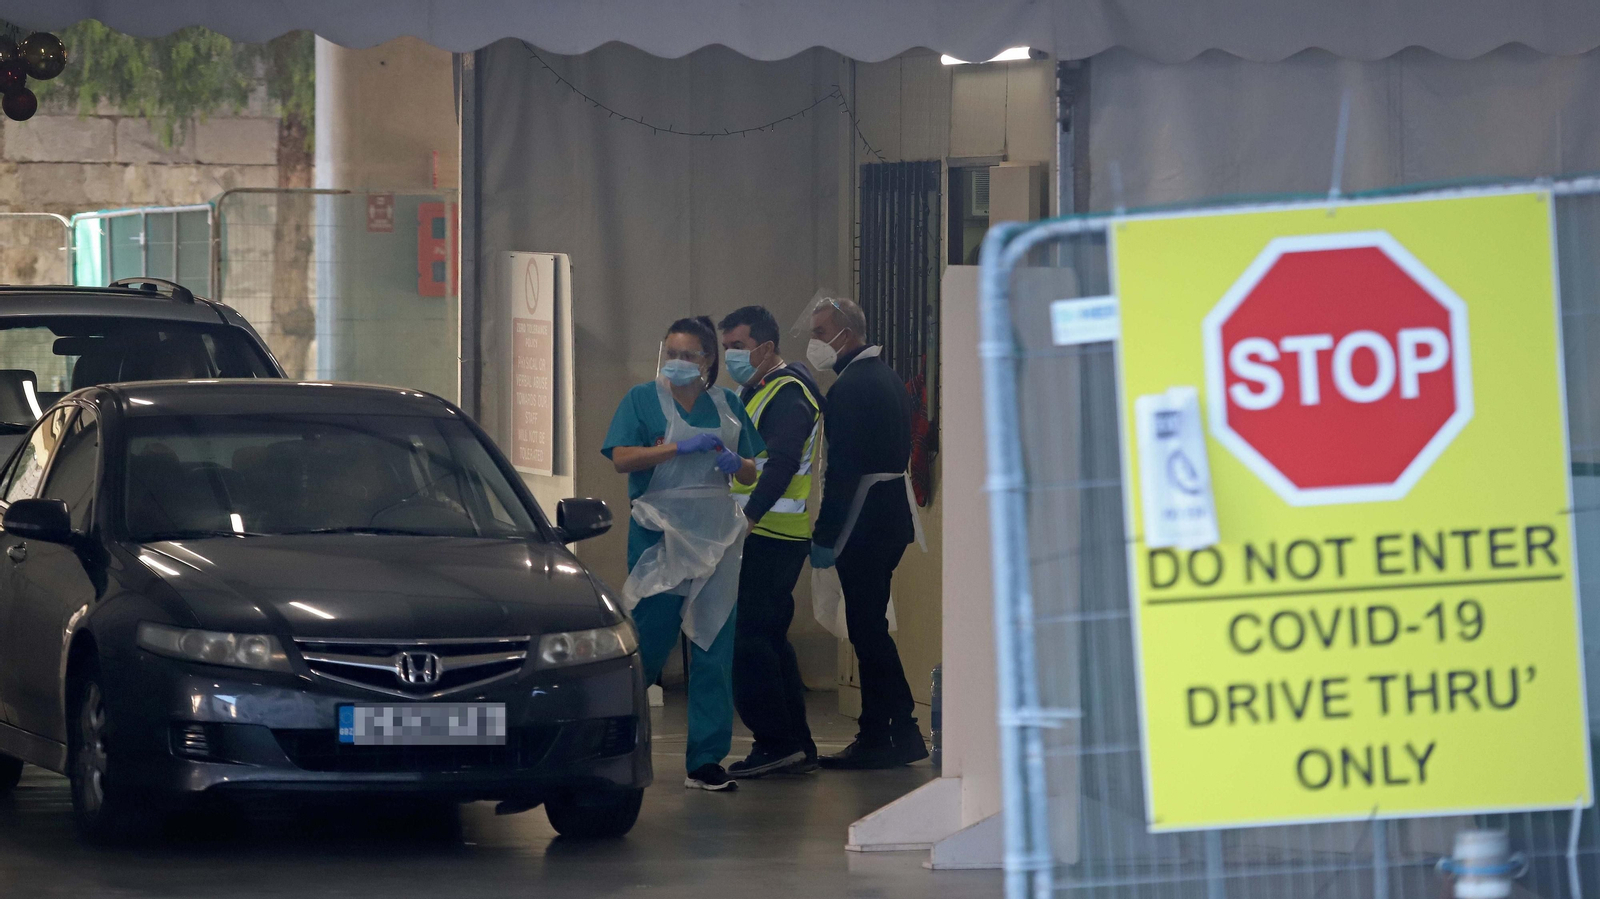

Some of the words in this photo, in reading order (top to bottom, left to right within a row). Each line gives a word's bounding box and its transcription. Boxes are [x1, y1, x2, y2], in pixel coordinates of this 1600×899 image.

[517, 355, 538, 371] PHYSICAL
[538, 358, 546, 371] OR
[1228, 327, 1450, 411] STOP
[516, 374, 532, 388] VERBAL
[532, 376, 548, 390] ABUSE
[516, 391, 536, 407] TOWARDS
[525, 411, 538, 424] STAFF
[518, 428, 529, 442] WILL
[529, 430, 538, 443] NOT
[539, 431, 545, 444] BE
[519, 446, 544, 462] TOLERATED
[1147, 546, 1224, 589] DO
[1244, 537, 1354, 584] NOT
[1375, 524, 1559, 576] ENTER
[1228, 600, 1486, 654] COVID-19
[1186, 677, 1352, 728] DRIVE
[1295, 741, 1436, 791] ONLY
